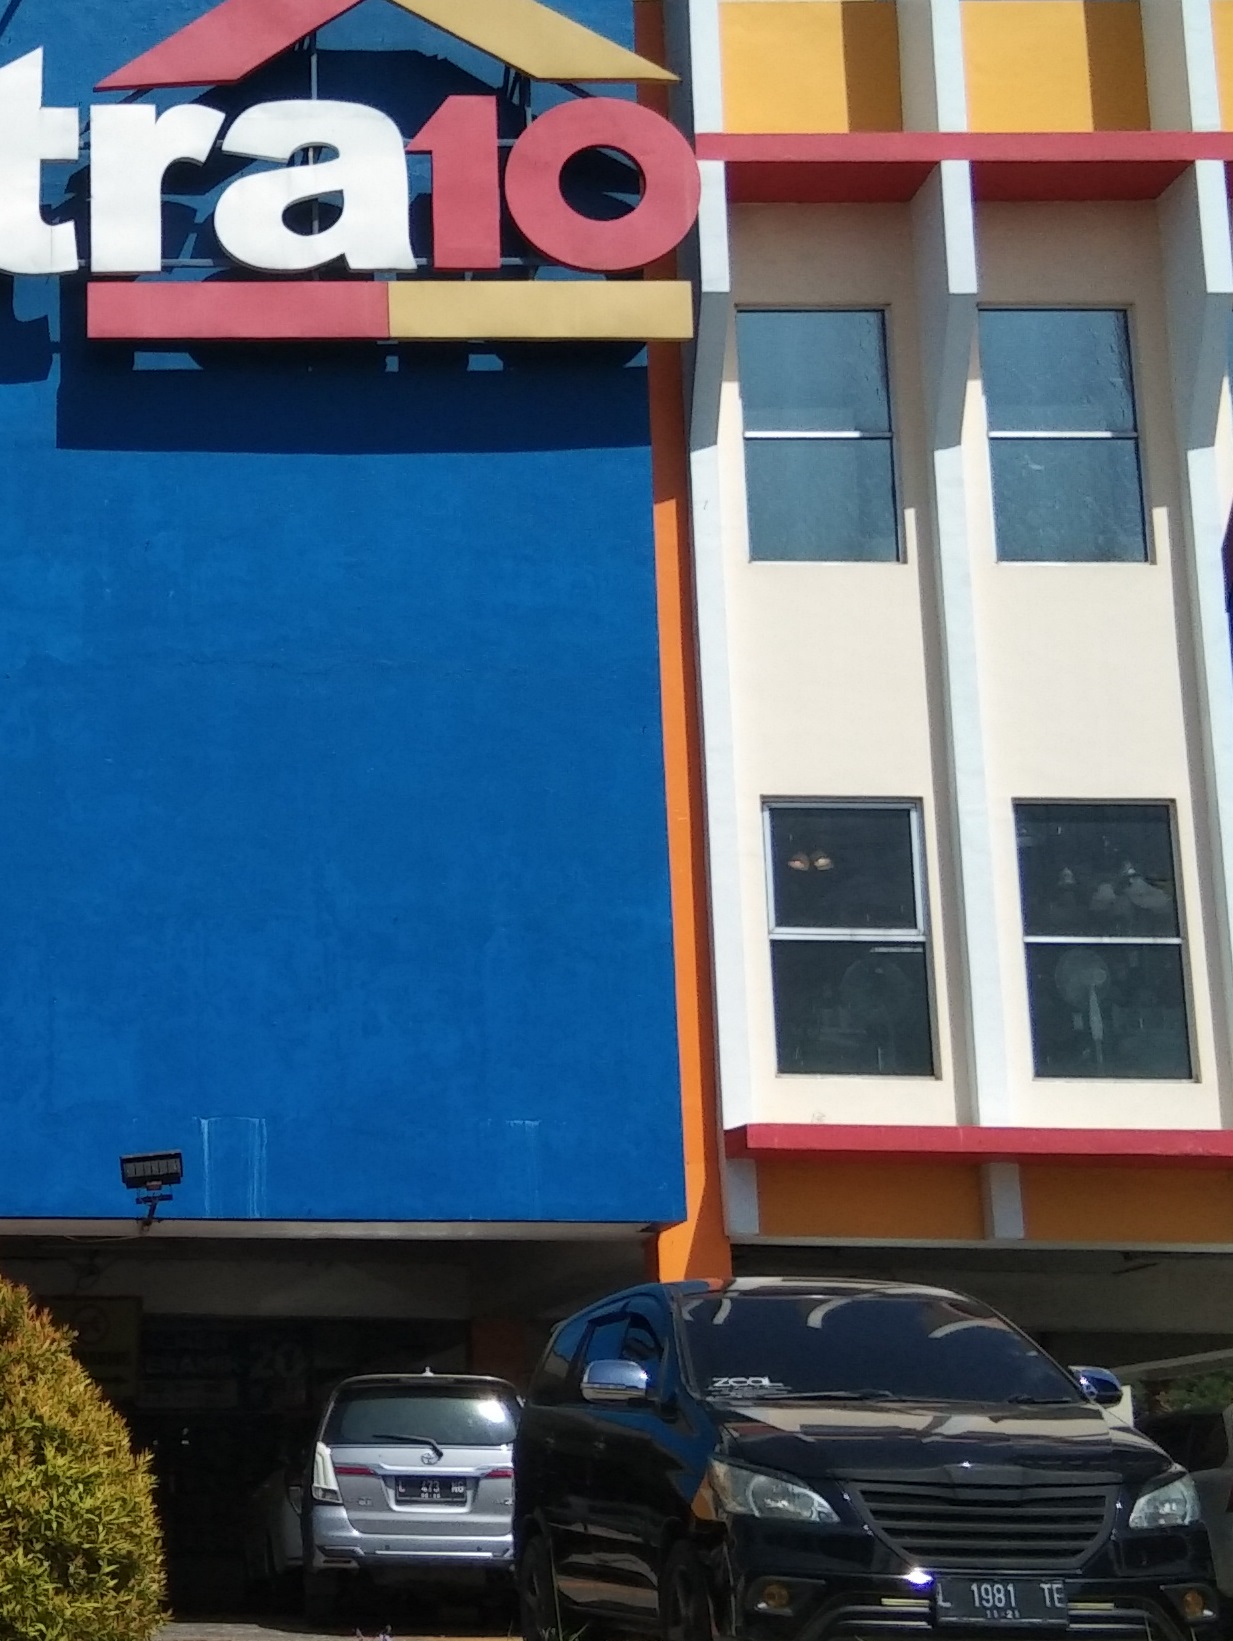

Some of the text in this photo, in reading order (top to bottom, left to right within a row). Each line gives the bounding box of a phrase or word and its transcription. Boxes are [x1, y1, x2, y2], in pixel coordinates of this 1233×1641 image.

[937, 1583, 1067, 1607] L 1981 TE
